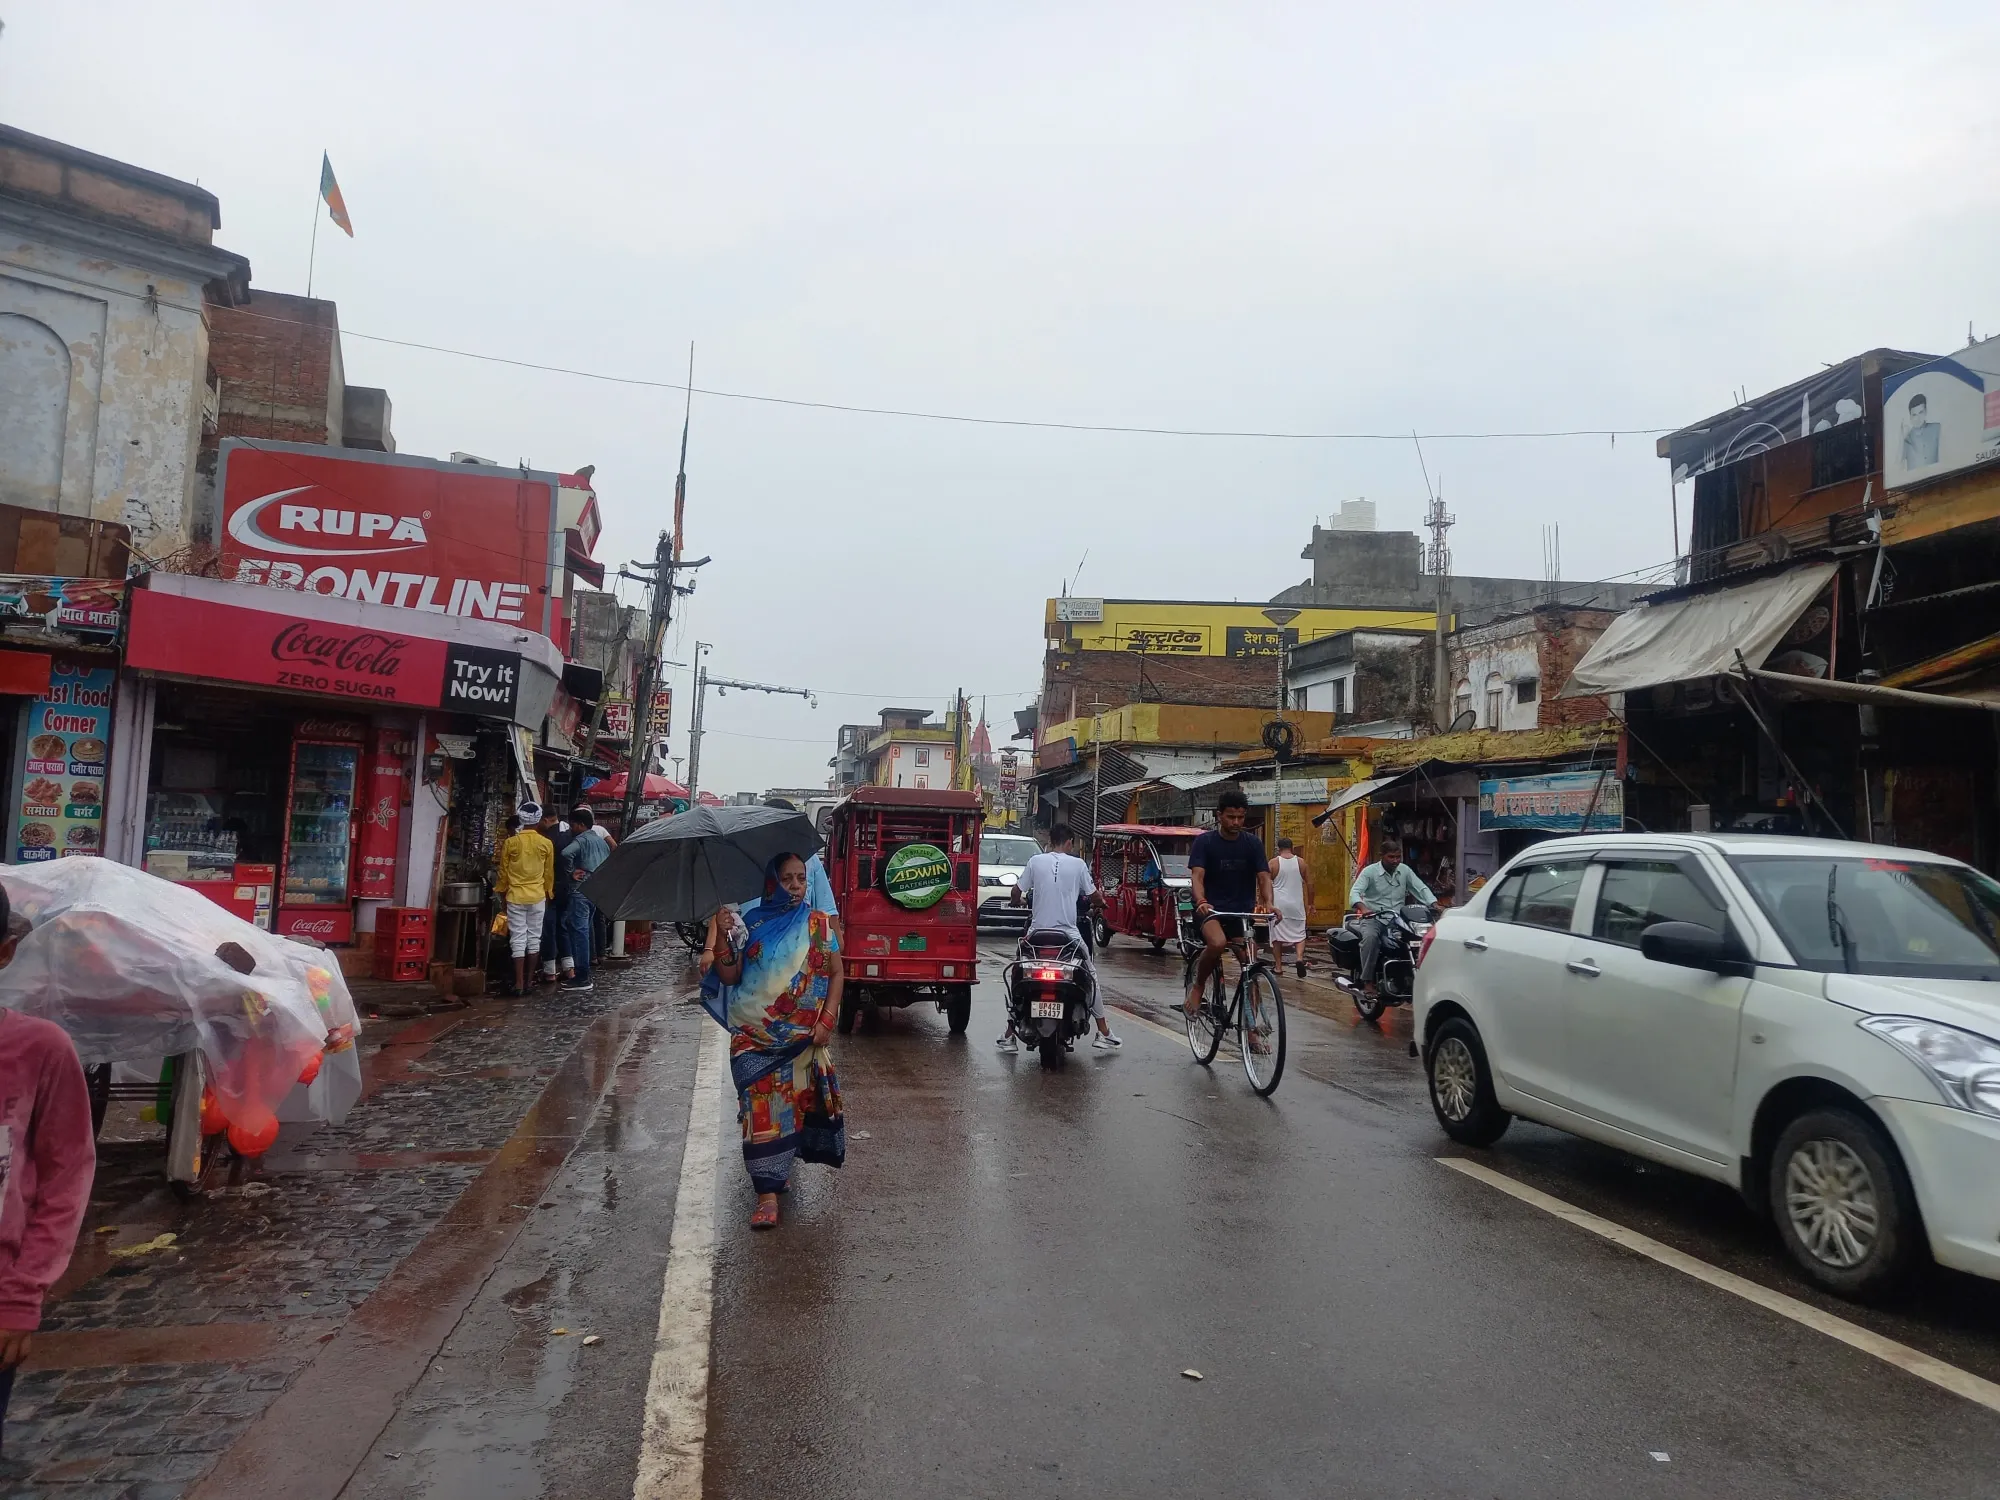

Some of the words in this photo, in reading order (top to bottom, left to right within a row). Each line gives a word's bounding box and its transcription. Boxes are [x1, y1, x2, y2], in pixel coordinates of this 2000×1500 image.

[279, 504, 428, 543] RUPA
[236, 559, 531, 621] FRONTLINE
[88, 610, 120, 627] भाजी
[271, 622, 409, 677] Coca-Cola
[1243, 630, 1264, 645] देश
[1264, 633, 1278, 645] का
[453, 659, 494, 684] Try
[497, 664, 514, 684] it
[33, 683, 70, 705] ast
[73, 681, 112, 708] Food
[276, 671, 329, 690] ZERO
[334, 679, 396, 699] SUGAR
[450, 679, 511, 703] Now!
[43, 707, 98, 735] Corner
[28, 761, 45, 774] आलू
[26, 805, 58, 816] समोसा
[891, 862, 948, 883] ADWIN
[899, 877, 940, 890] BATTERIES
[291, 918, 337, 933] Coca-Cola
